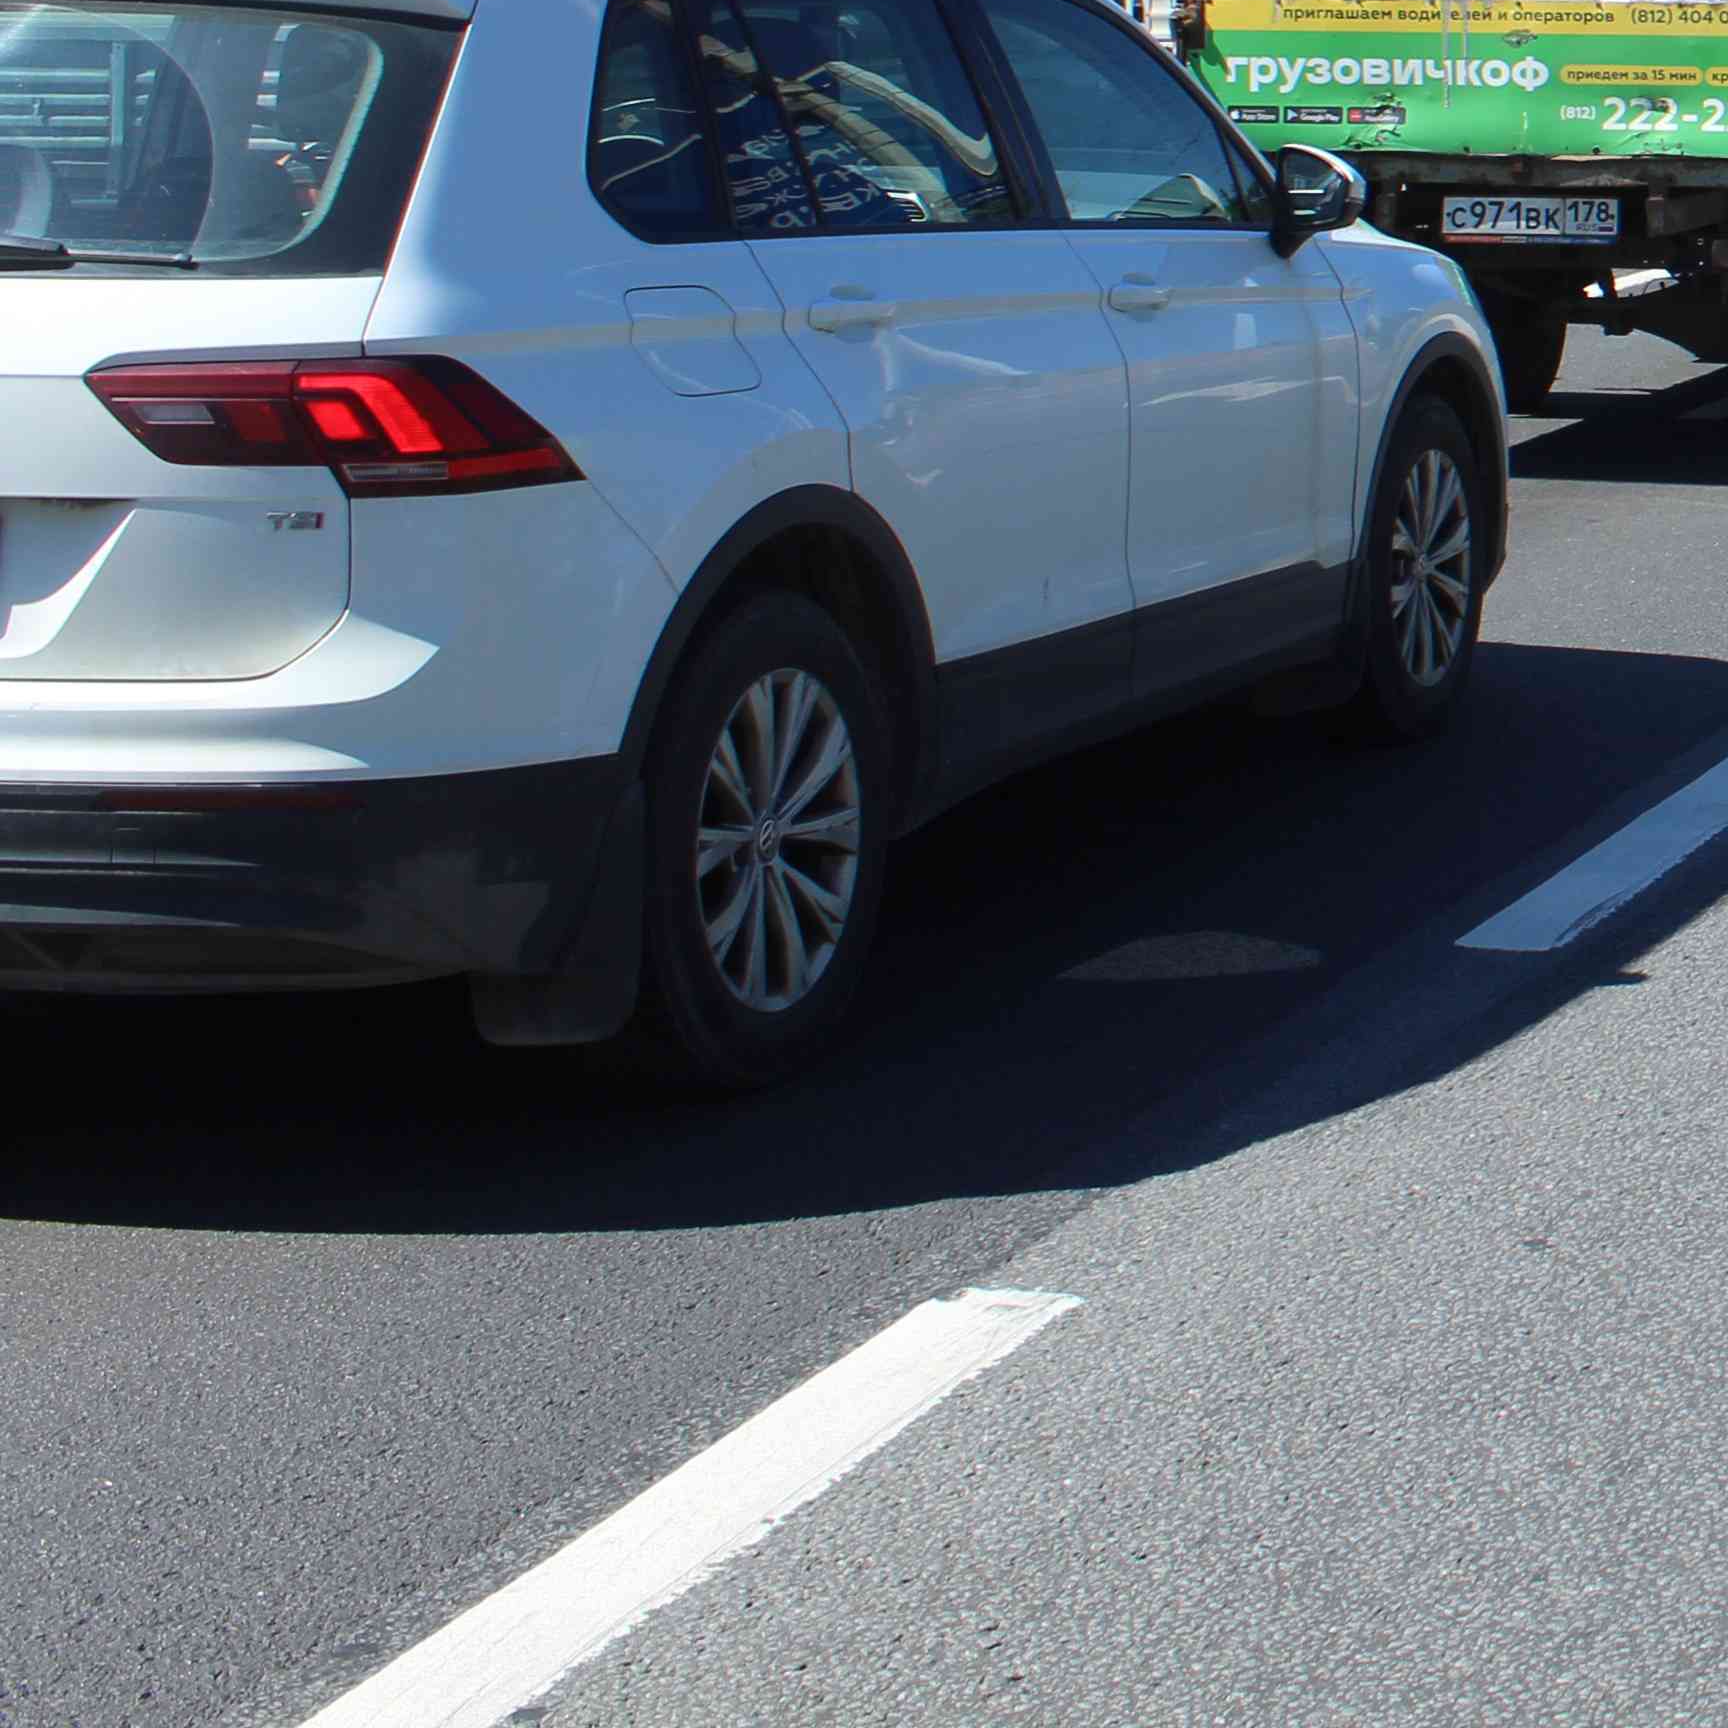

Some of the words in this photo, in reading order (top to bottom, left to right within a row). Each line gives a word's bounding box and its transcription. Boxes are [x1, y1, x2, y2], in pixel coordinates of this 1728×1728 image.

[1282, 6, 1393, 22] приглашаем
[1512, 10, 1615, 25] операторов
[1630, 8, 1673, 25] (812)
[1678, 9, 1714, 25] 404
[1226, 55, 1549, 94] грузовичкоф
[1566, 69, 1628, 84] приедем
[1631, 71, 1648, 81] за
[1651, 69, 1665, 81] 15
[1668, 71, 1697, 82] мин
[1559, 105, 1597, 122] (812)
[1451, 200, 1561, 230] С971ВК
[1567, 200, 1611, 223] 178
